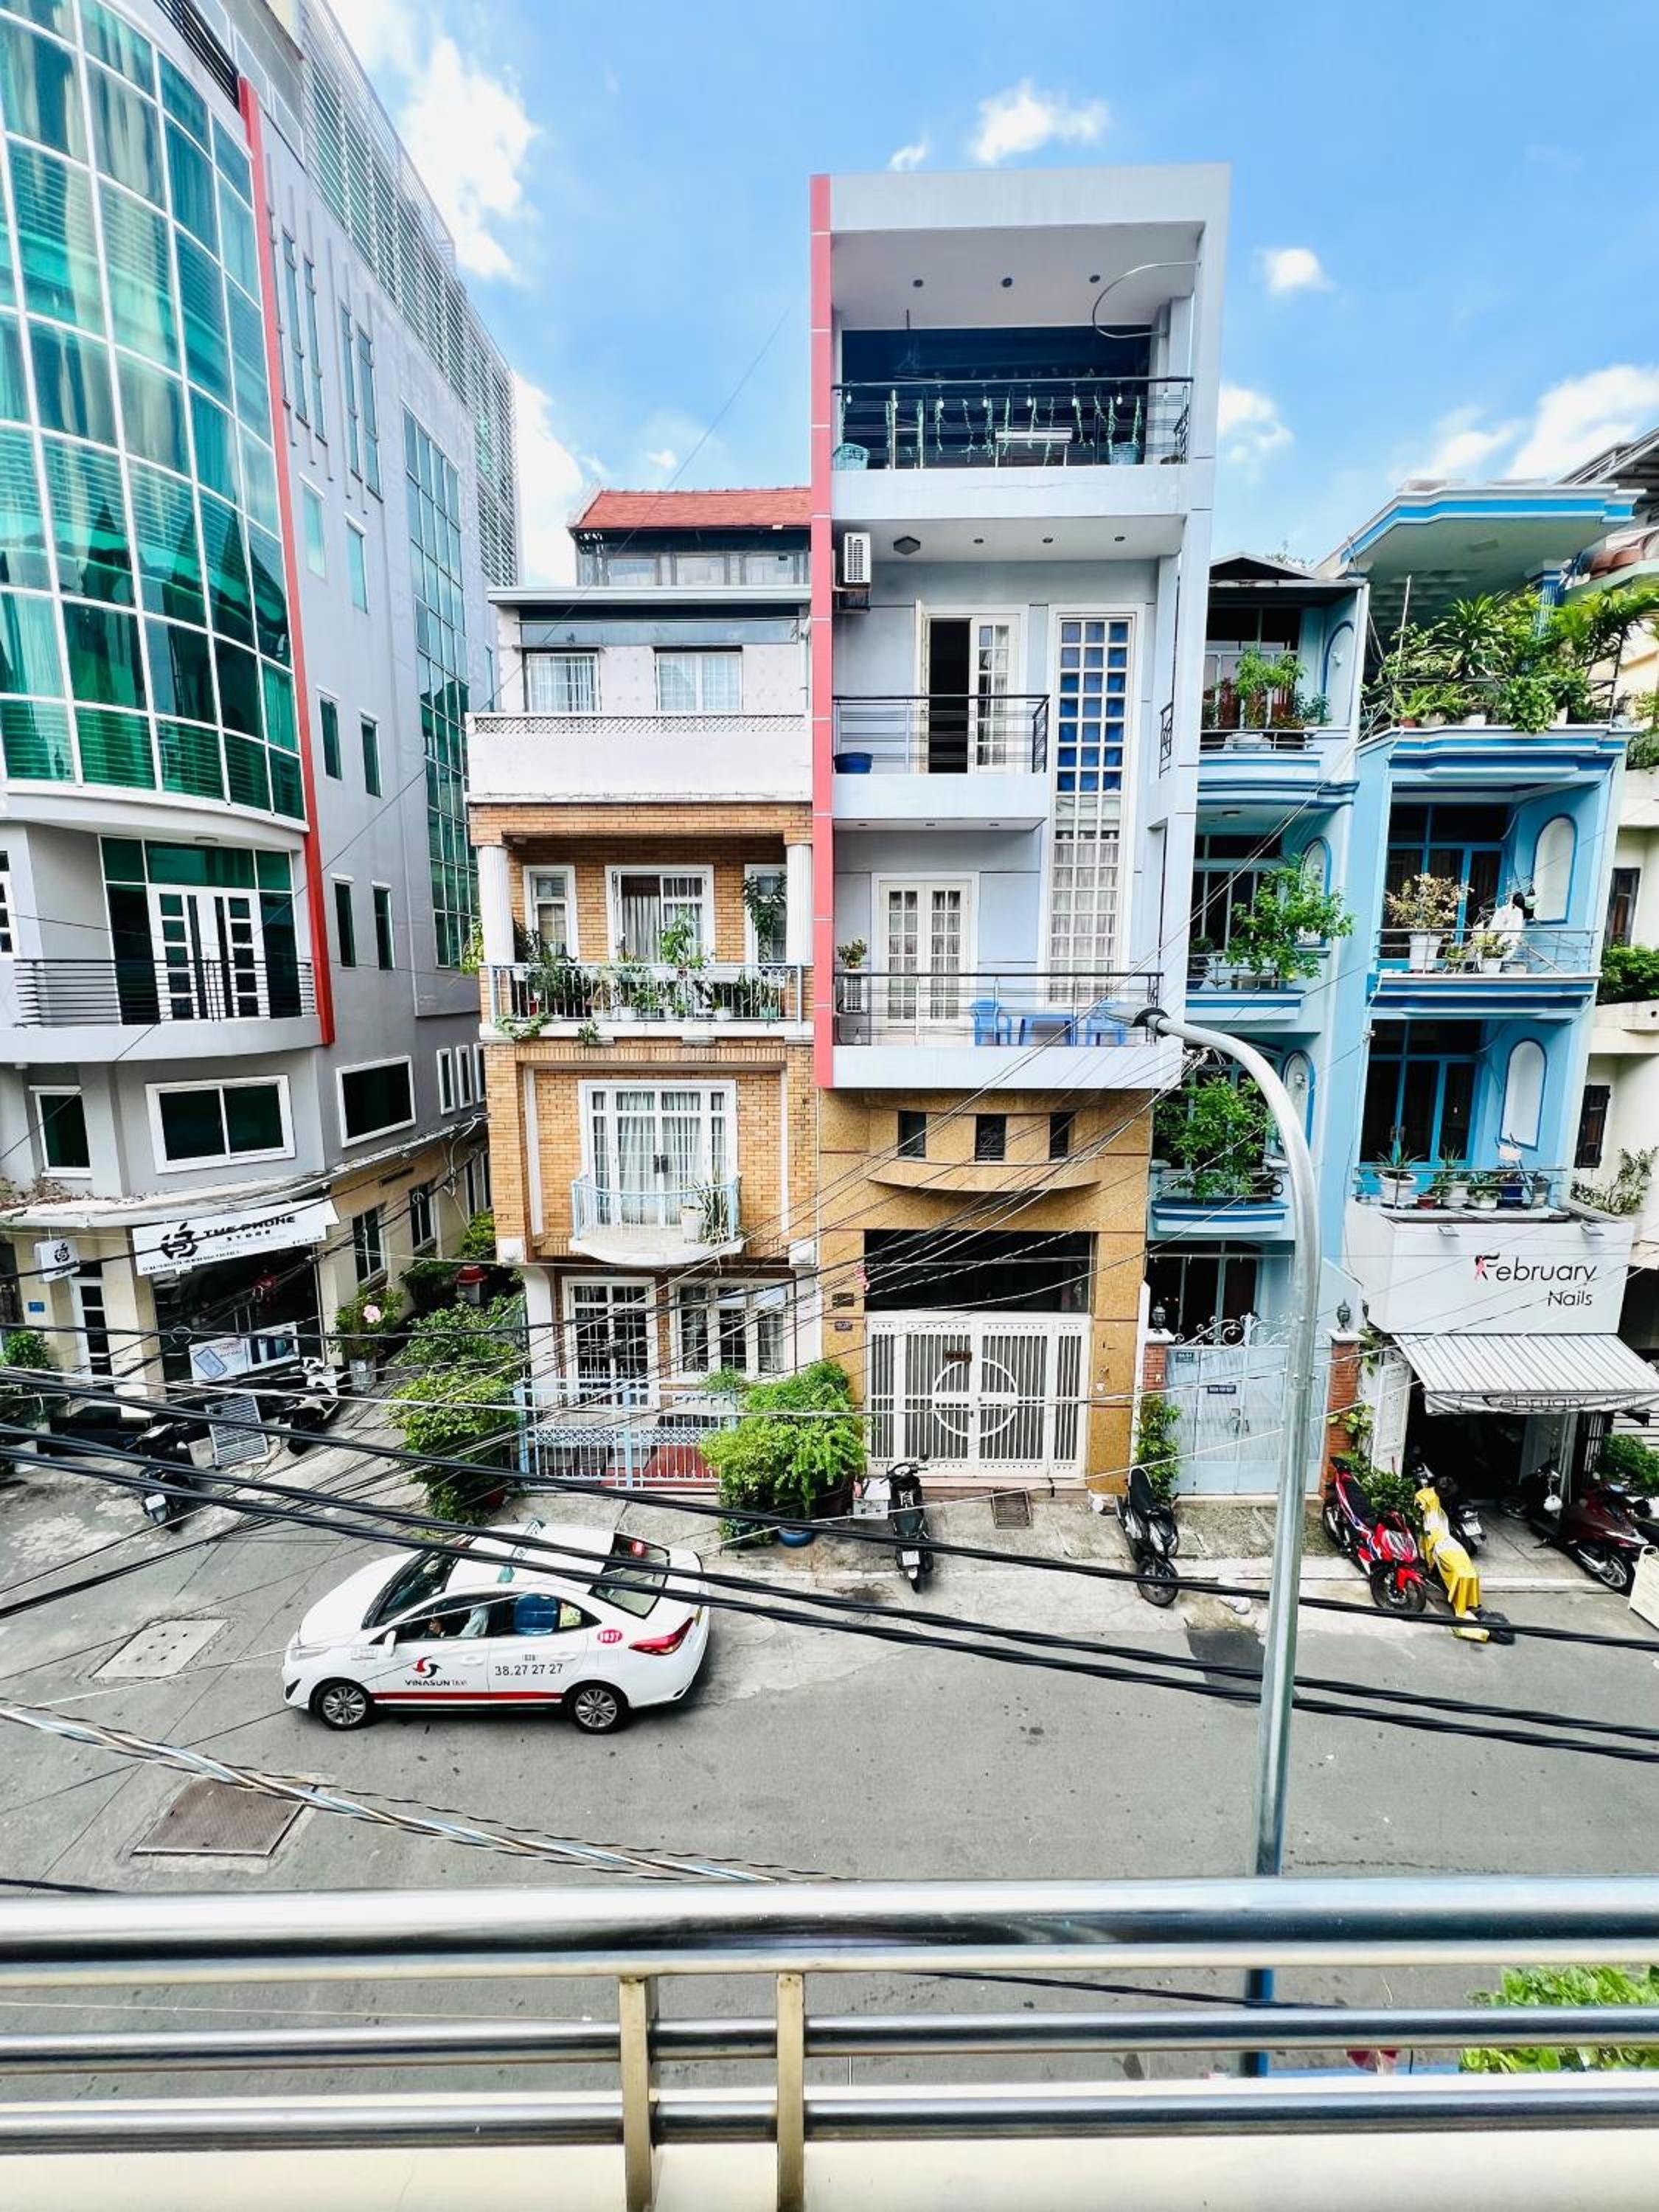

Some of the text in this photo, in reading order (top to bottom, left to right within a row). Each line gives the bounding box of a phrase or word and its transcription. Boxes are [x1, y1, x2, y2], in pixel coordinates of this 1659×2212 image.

[240, 1216, 296, 1231] PHONE
[1474, 1251, 1598, 1284] February
[1547, 1290, 1593, 1307] Nails
[532, 1664, 545, 1674] 27
[549, 1663, 564, 1674] 27
[404, 1679, 451, 1687] VINASUN
